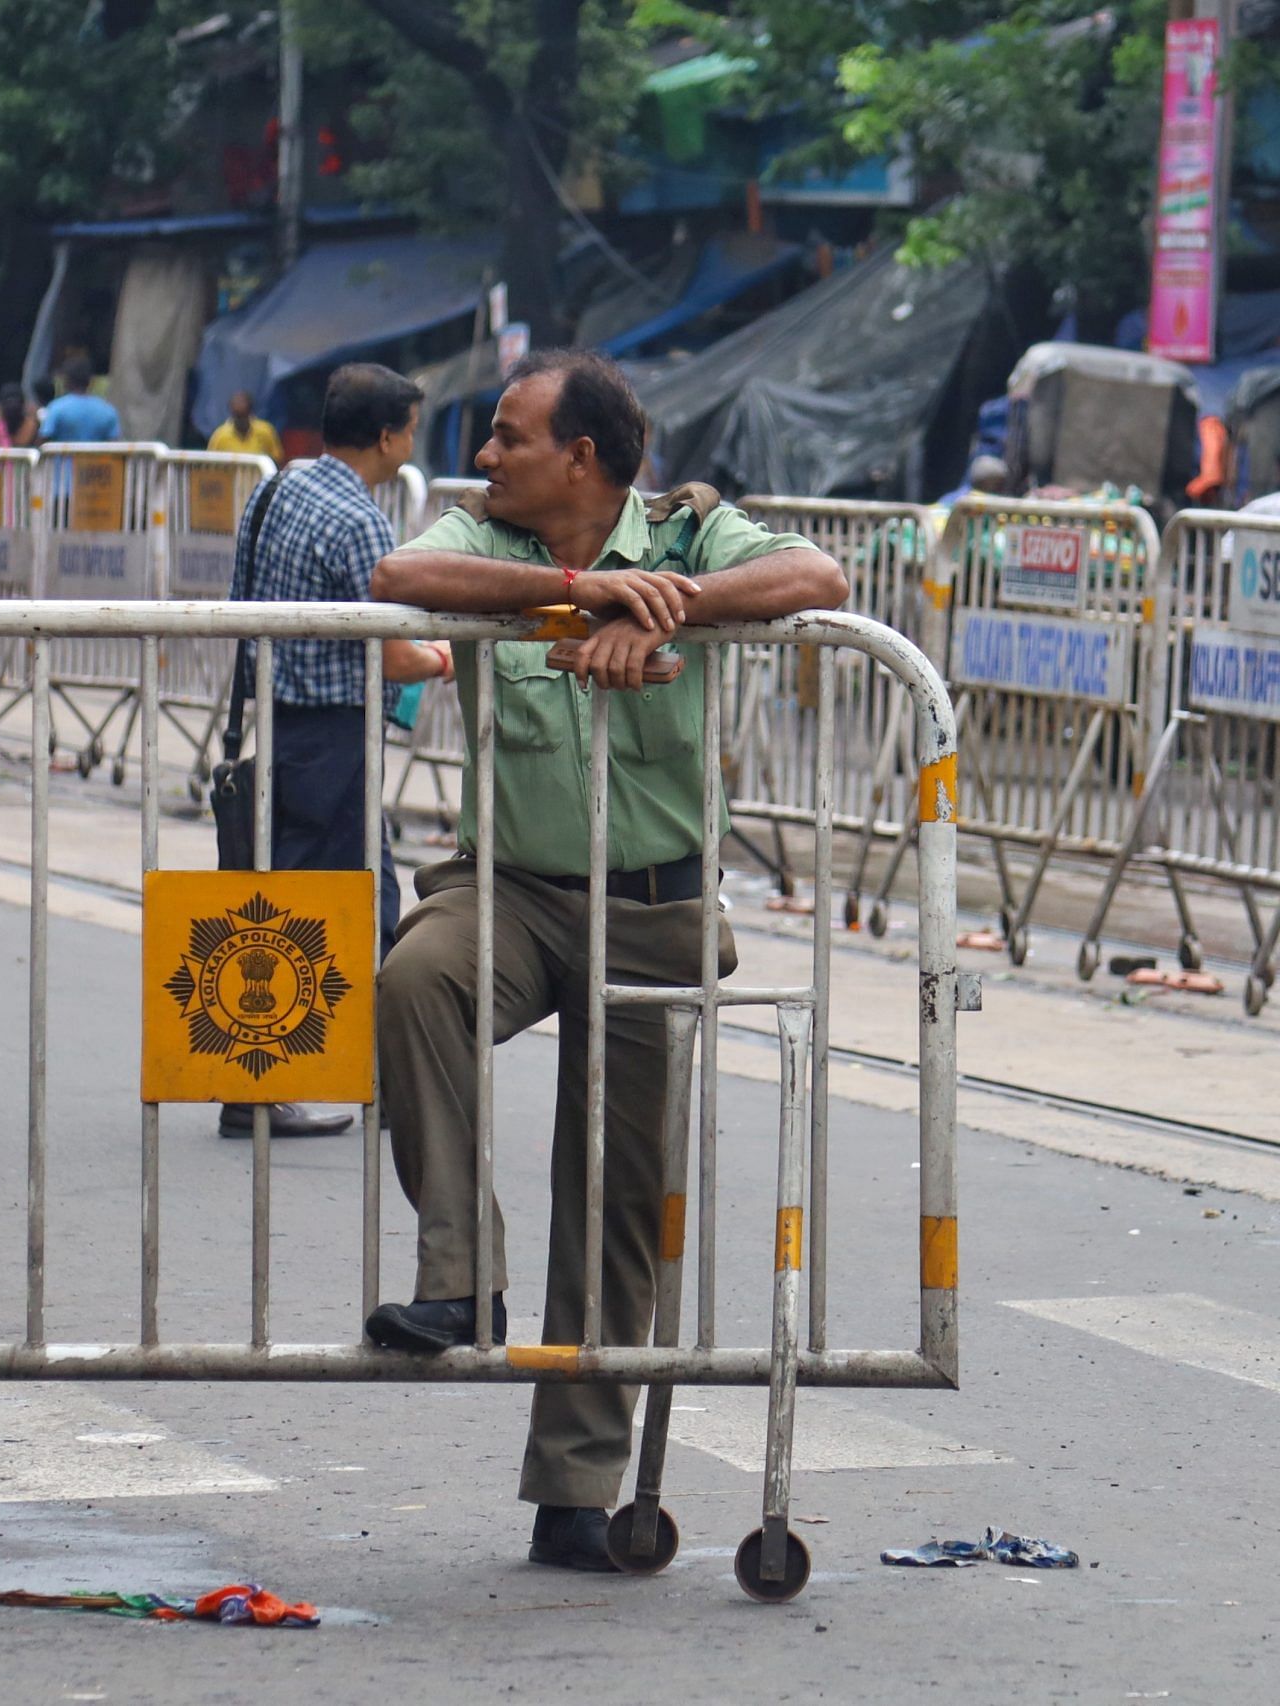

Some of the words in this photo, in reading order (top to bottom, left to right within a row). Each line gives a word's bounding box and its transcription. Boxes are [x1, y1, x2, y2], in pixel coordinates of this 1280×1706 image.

[1024, 533, 1077, 568] SERVO
[203, 940, 238, 1007] KOLKATA
[240, 931, 297, 956] POLICE
[294, 955, 313, 1008] FORCE
